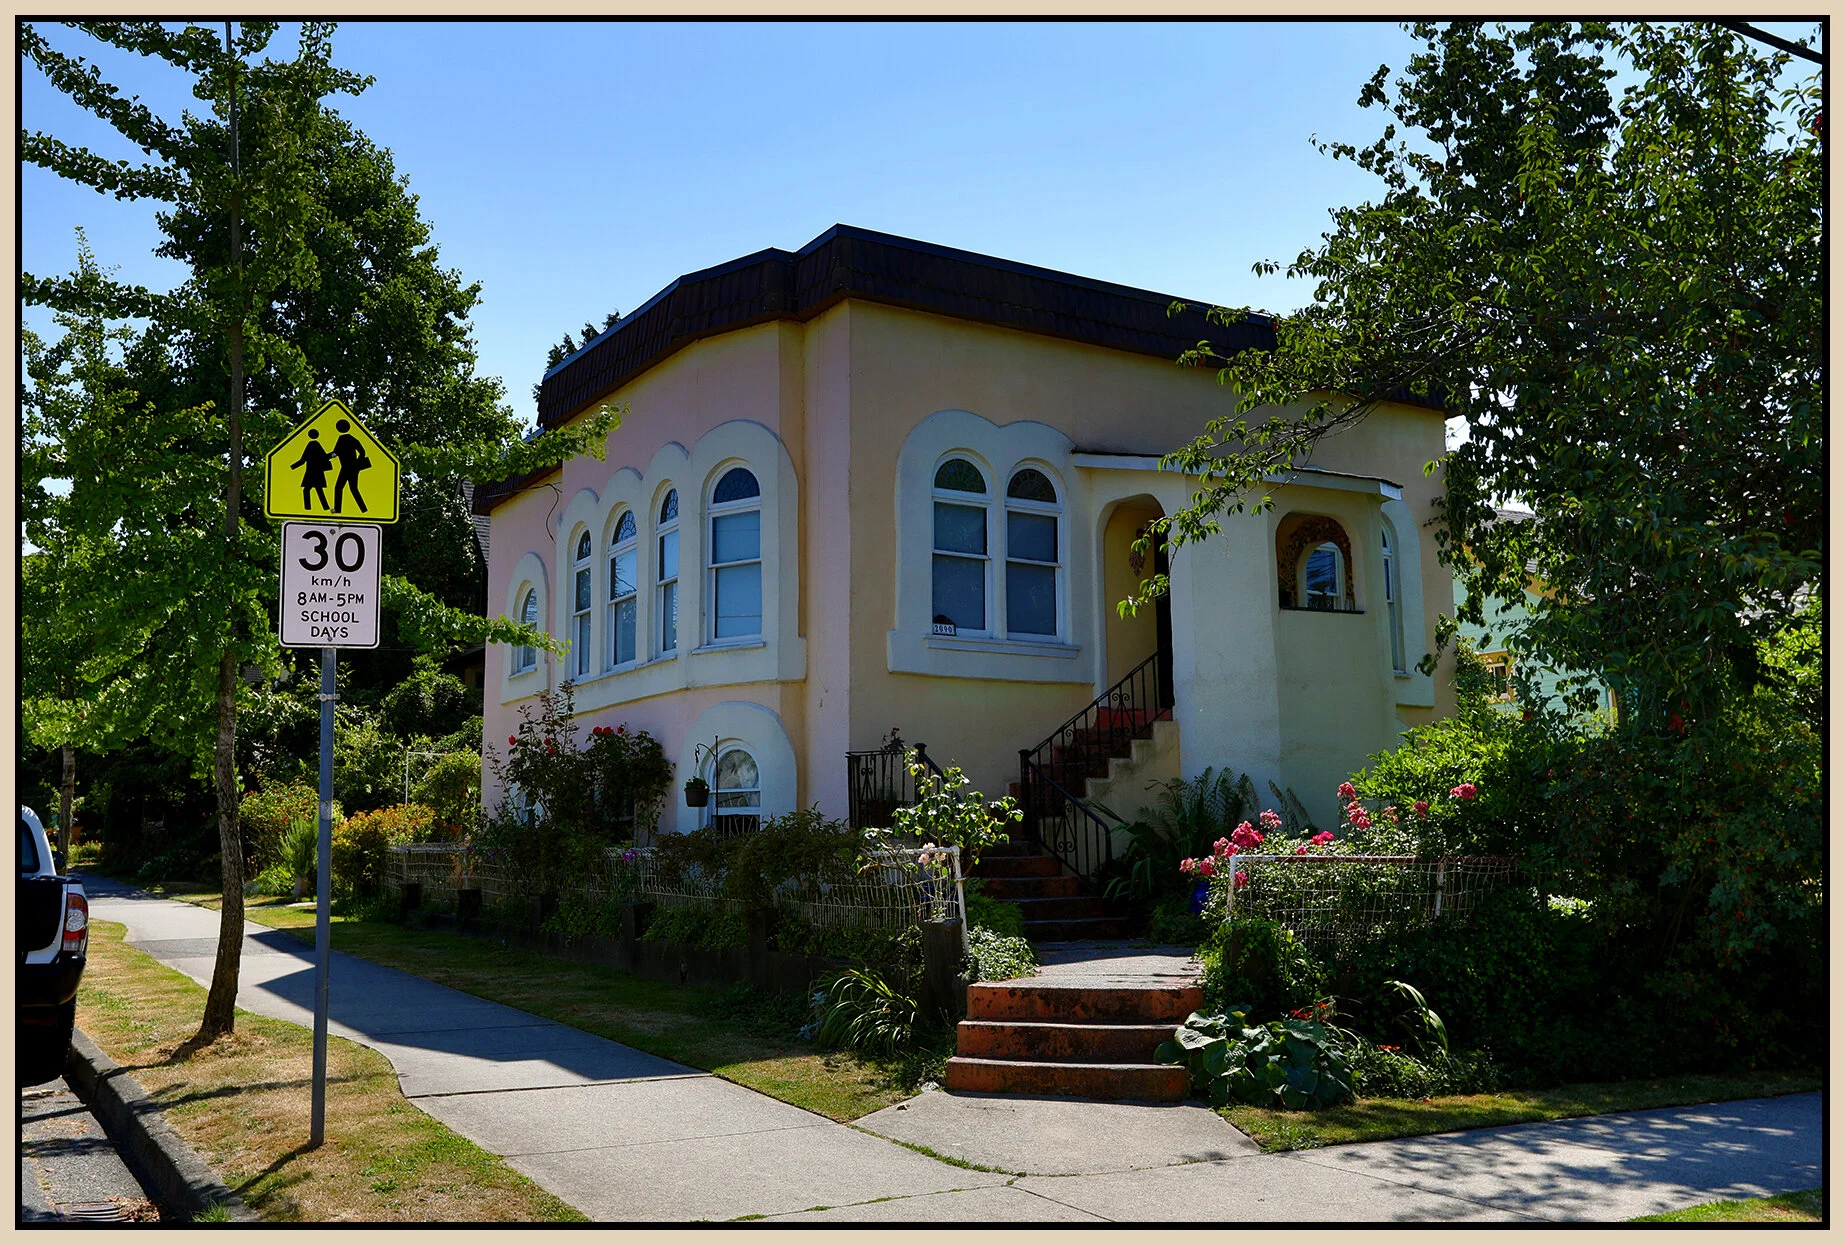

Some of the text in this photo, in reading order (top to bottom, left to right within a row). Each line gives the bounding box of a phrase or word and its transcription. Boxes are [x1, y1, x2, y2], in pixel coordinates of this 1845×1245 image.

[299, 530, 365, 572] 30
[311, 575, 351, 587] km/h
[301, 610, 359, 623] SCHOOL
[311, 626, 349, 638] DAYS
